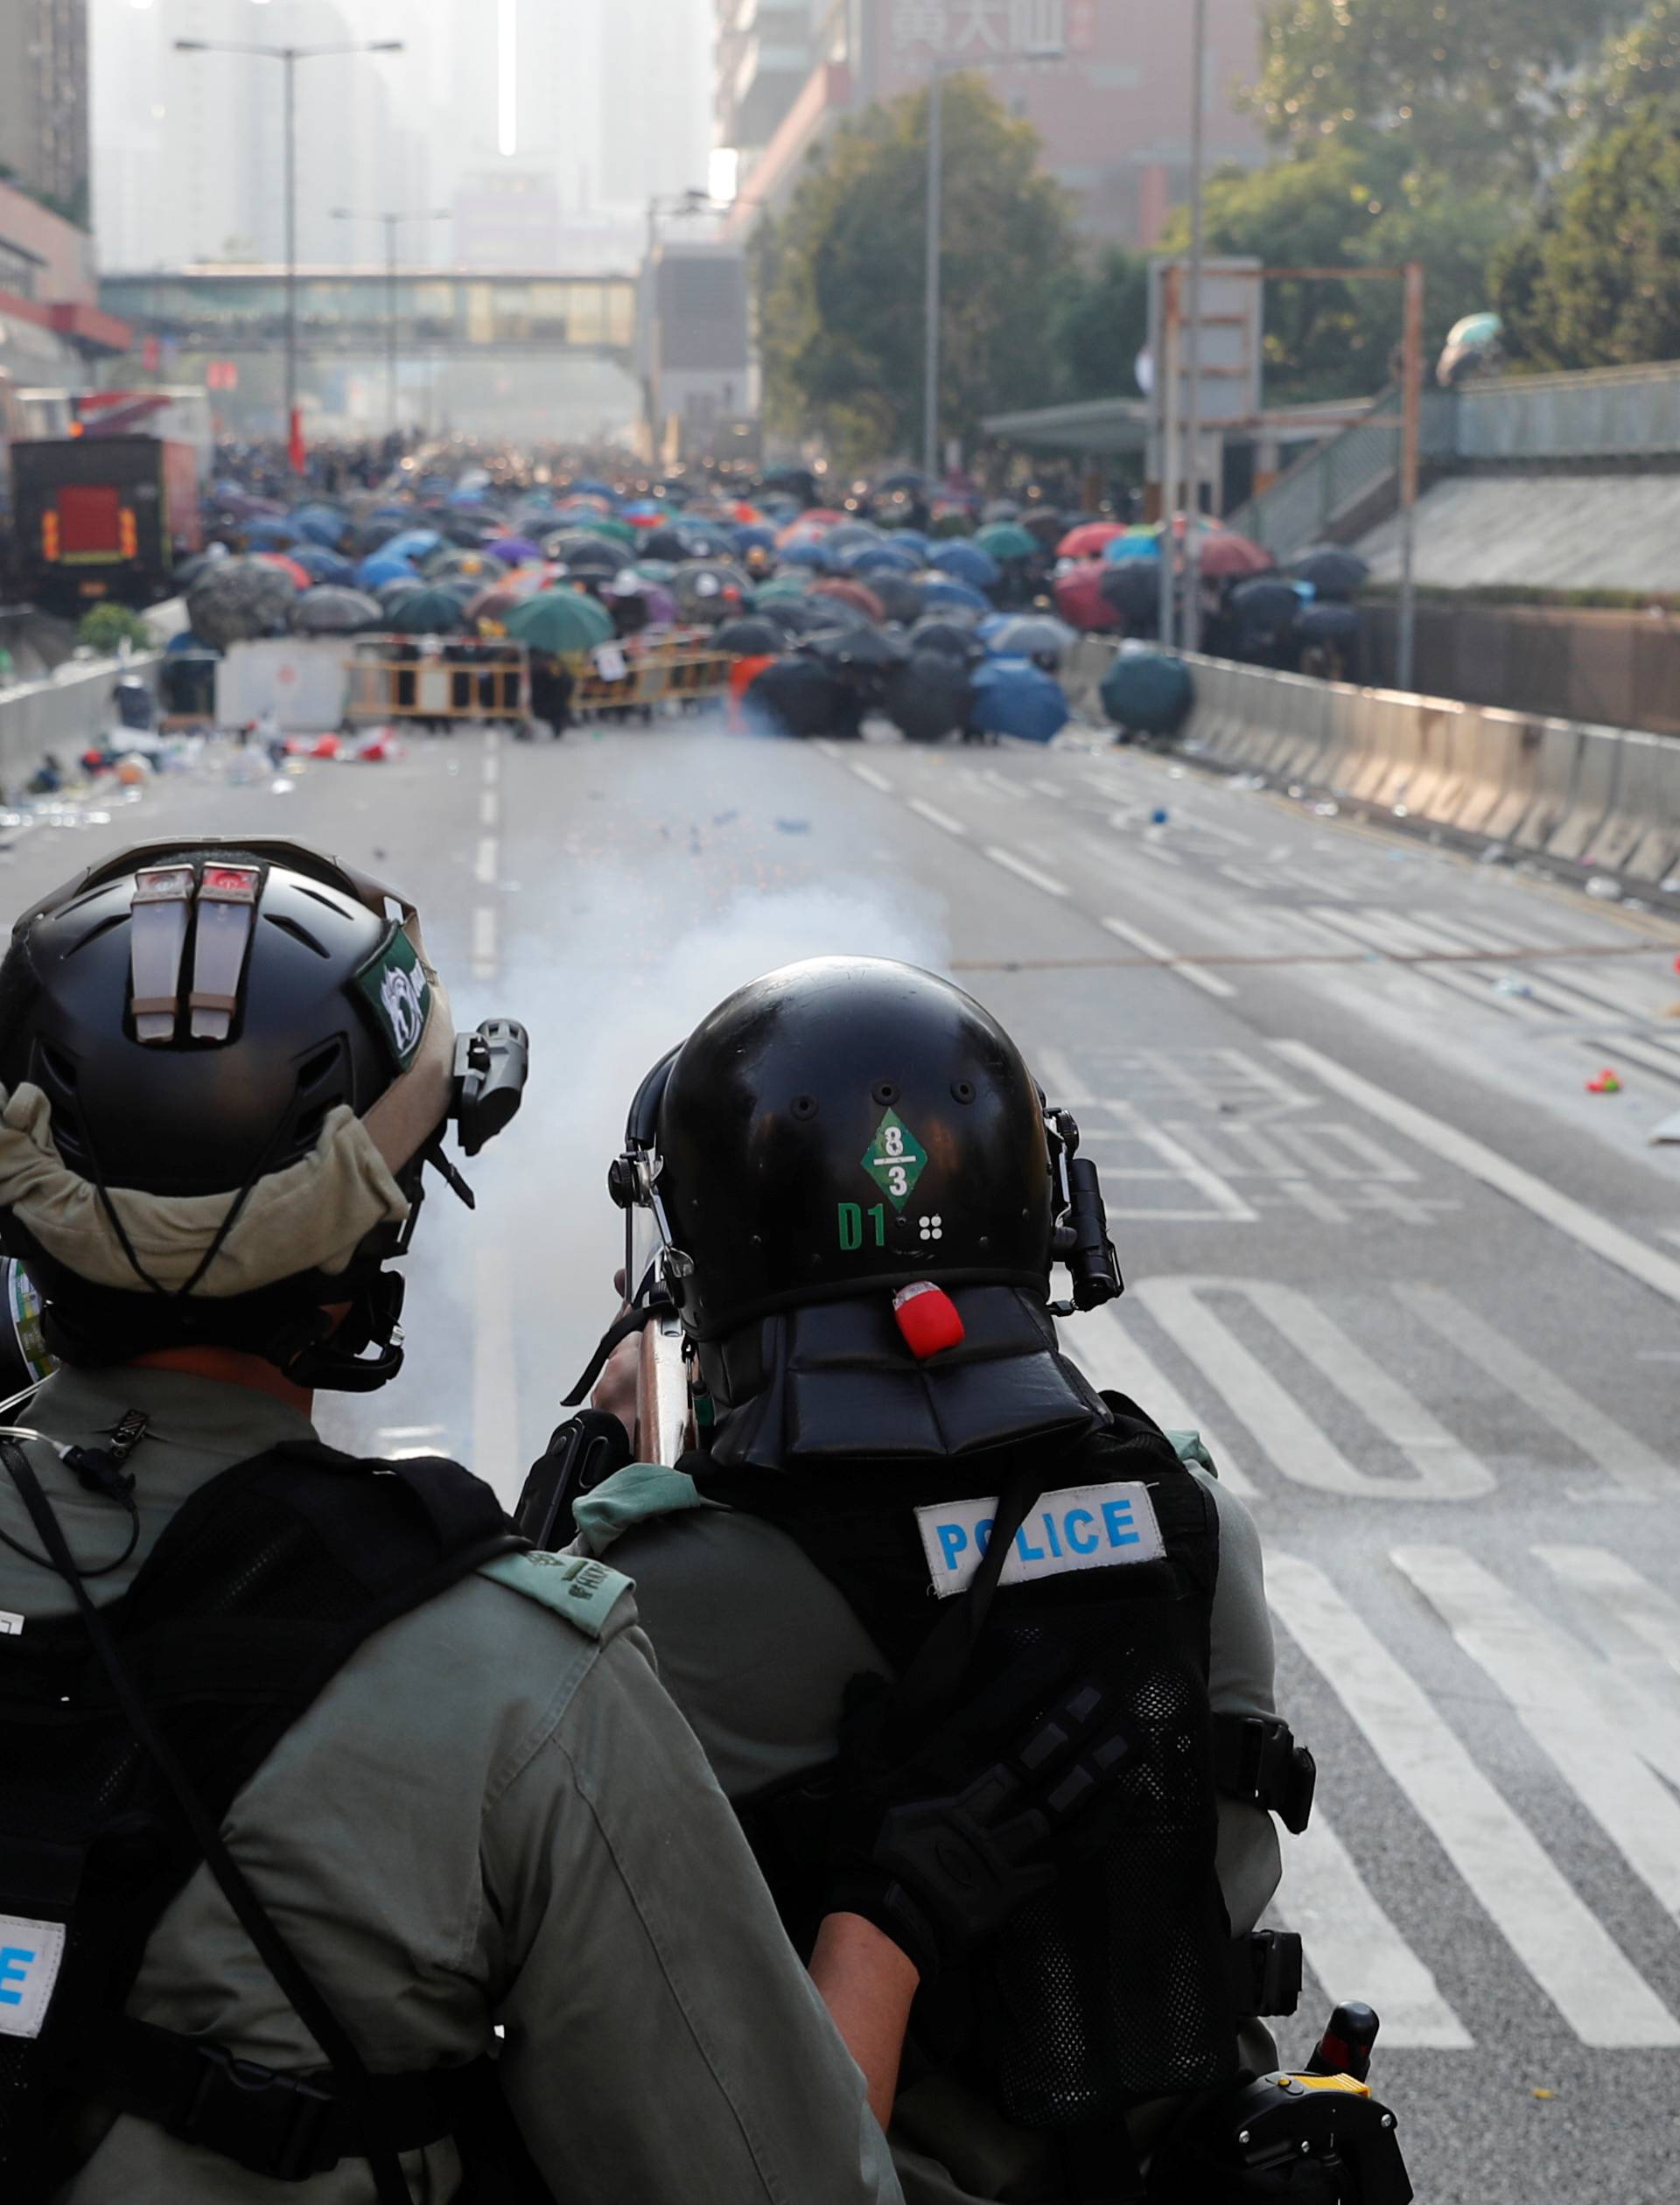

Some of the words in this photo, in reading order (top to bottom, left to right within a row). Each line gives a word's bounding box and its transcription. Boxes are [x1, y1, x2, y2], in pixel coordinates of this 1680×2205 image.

[885, 1126, 904, 1157] 8
[888, 1166, 907, 1196] 3
[837, 1202, 886, 1250] D1
